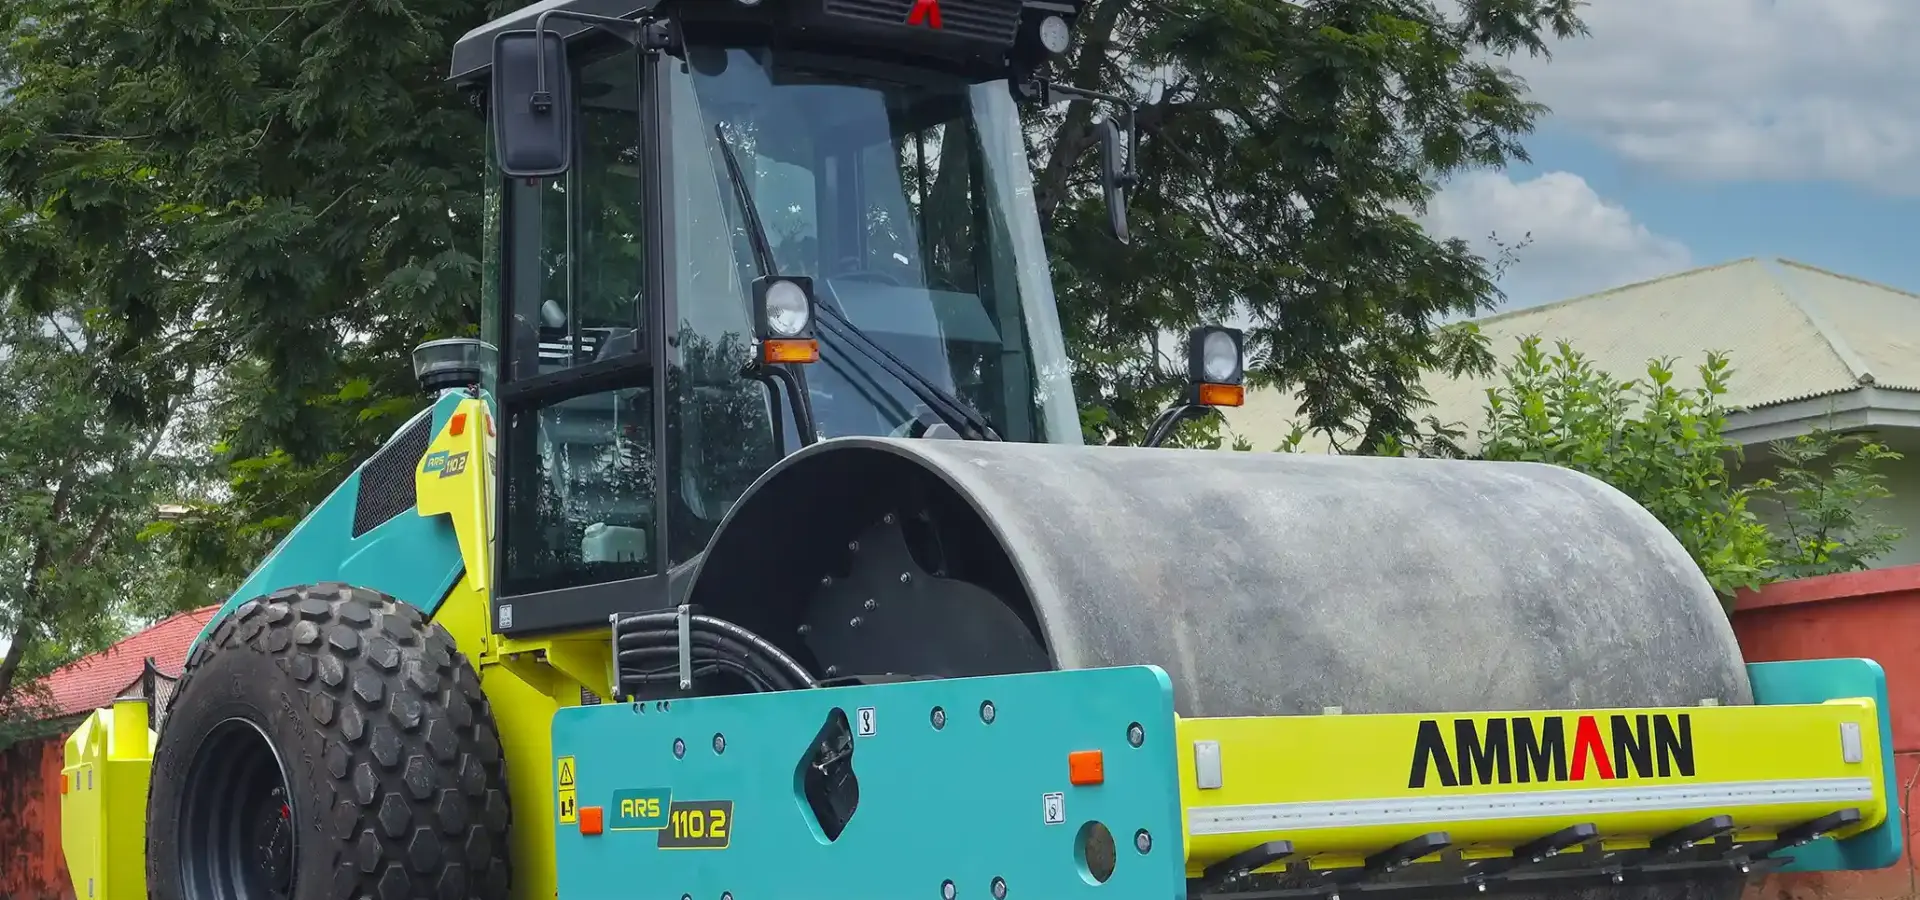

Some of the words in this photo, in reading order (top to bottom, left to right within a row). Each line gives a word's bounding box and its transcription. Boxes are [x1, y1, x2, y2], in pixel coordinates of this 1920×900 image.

[1408, 714, 1696, 789] AMMANN
[621, 798, 660, 818] ARS
[672, 809, 726, 839] 110.2
